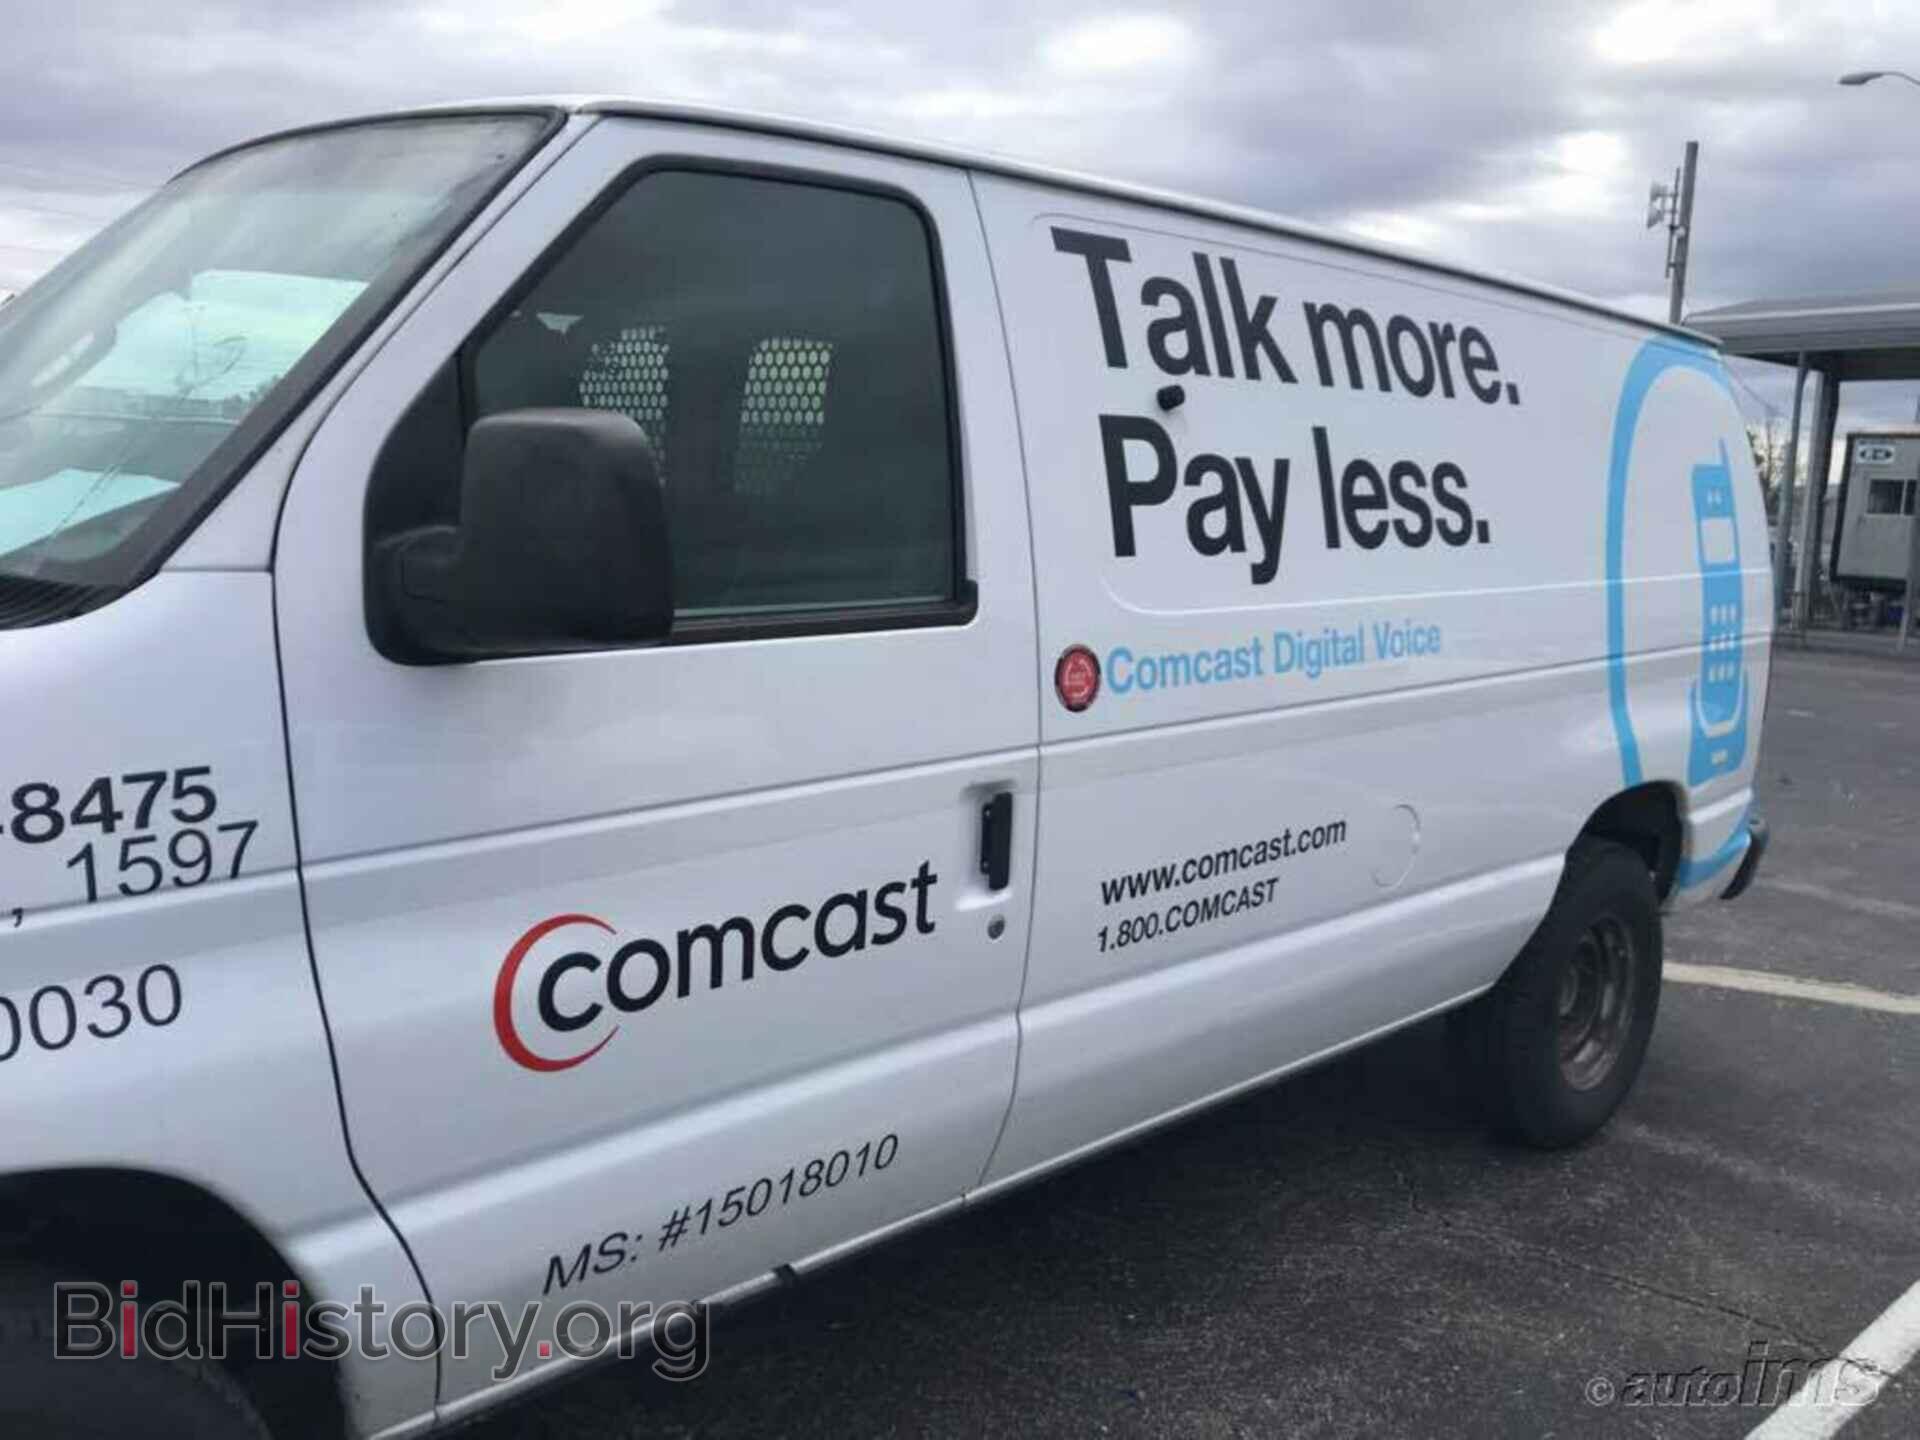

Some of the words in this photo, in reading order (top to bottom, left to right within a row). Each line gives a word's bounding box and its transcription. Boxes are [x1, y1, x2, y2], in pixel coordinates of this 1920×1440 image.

[1050, 225, 1298, 384] Talk
[1302, 300, 1520, 405] more.
[1098, 413, 1290, 585] Pay
[1312, 426, 1490, 550] less.
[1106, 638, 1263, 694] Comcast
[1273, 624, 1364, 679] Digital
[1372, 620, 1440, 659] Voice
[0, 765, 217, 844] 8475
[66, 819, 259, 902] 1597
[1100, 818, 1347, 906] www.comcast.com
[1097, 877, 1279, 952] 1.800.COMCAST
[542, 1232, 643, 1296] MS:
[658, 1133, 899, 1253] #15018010
